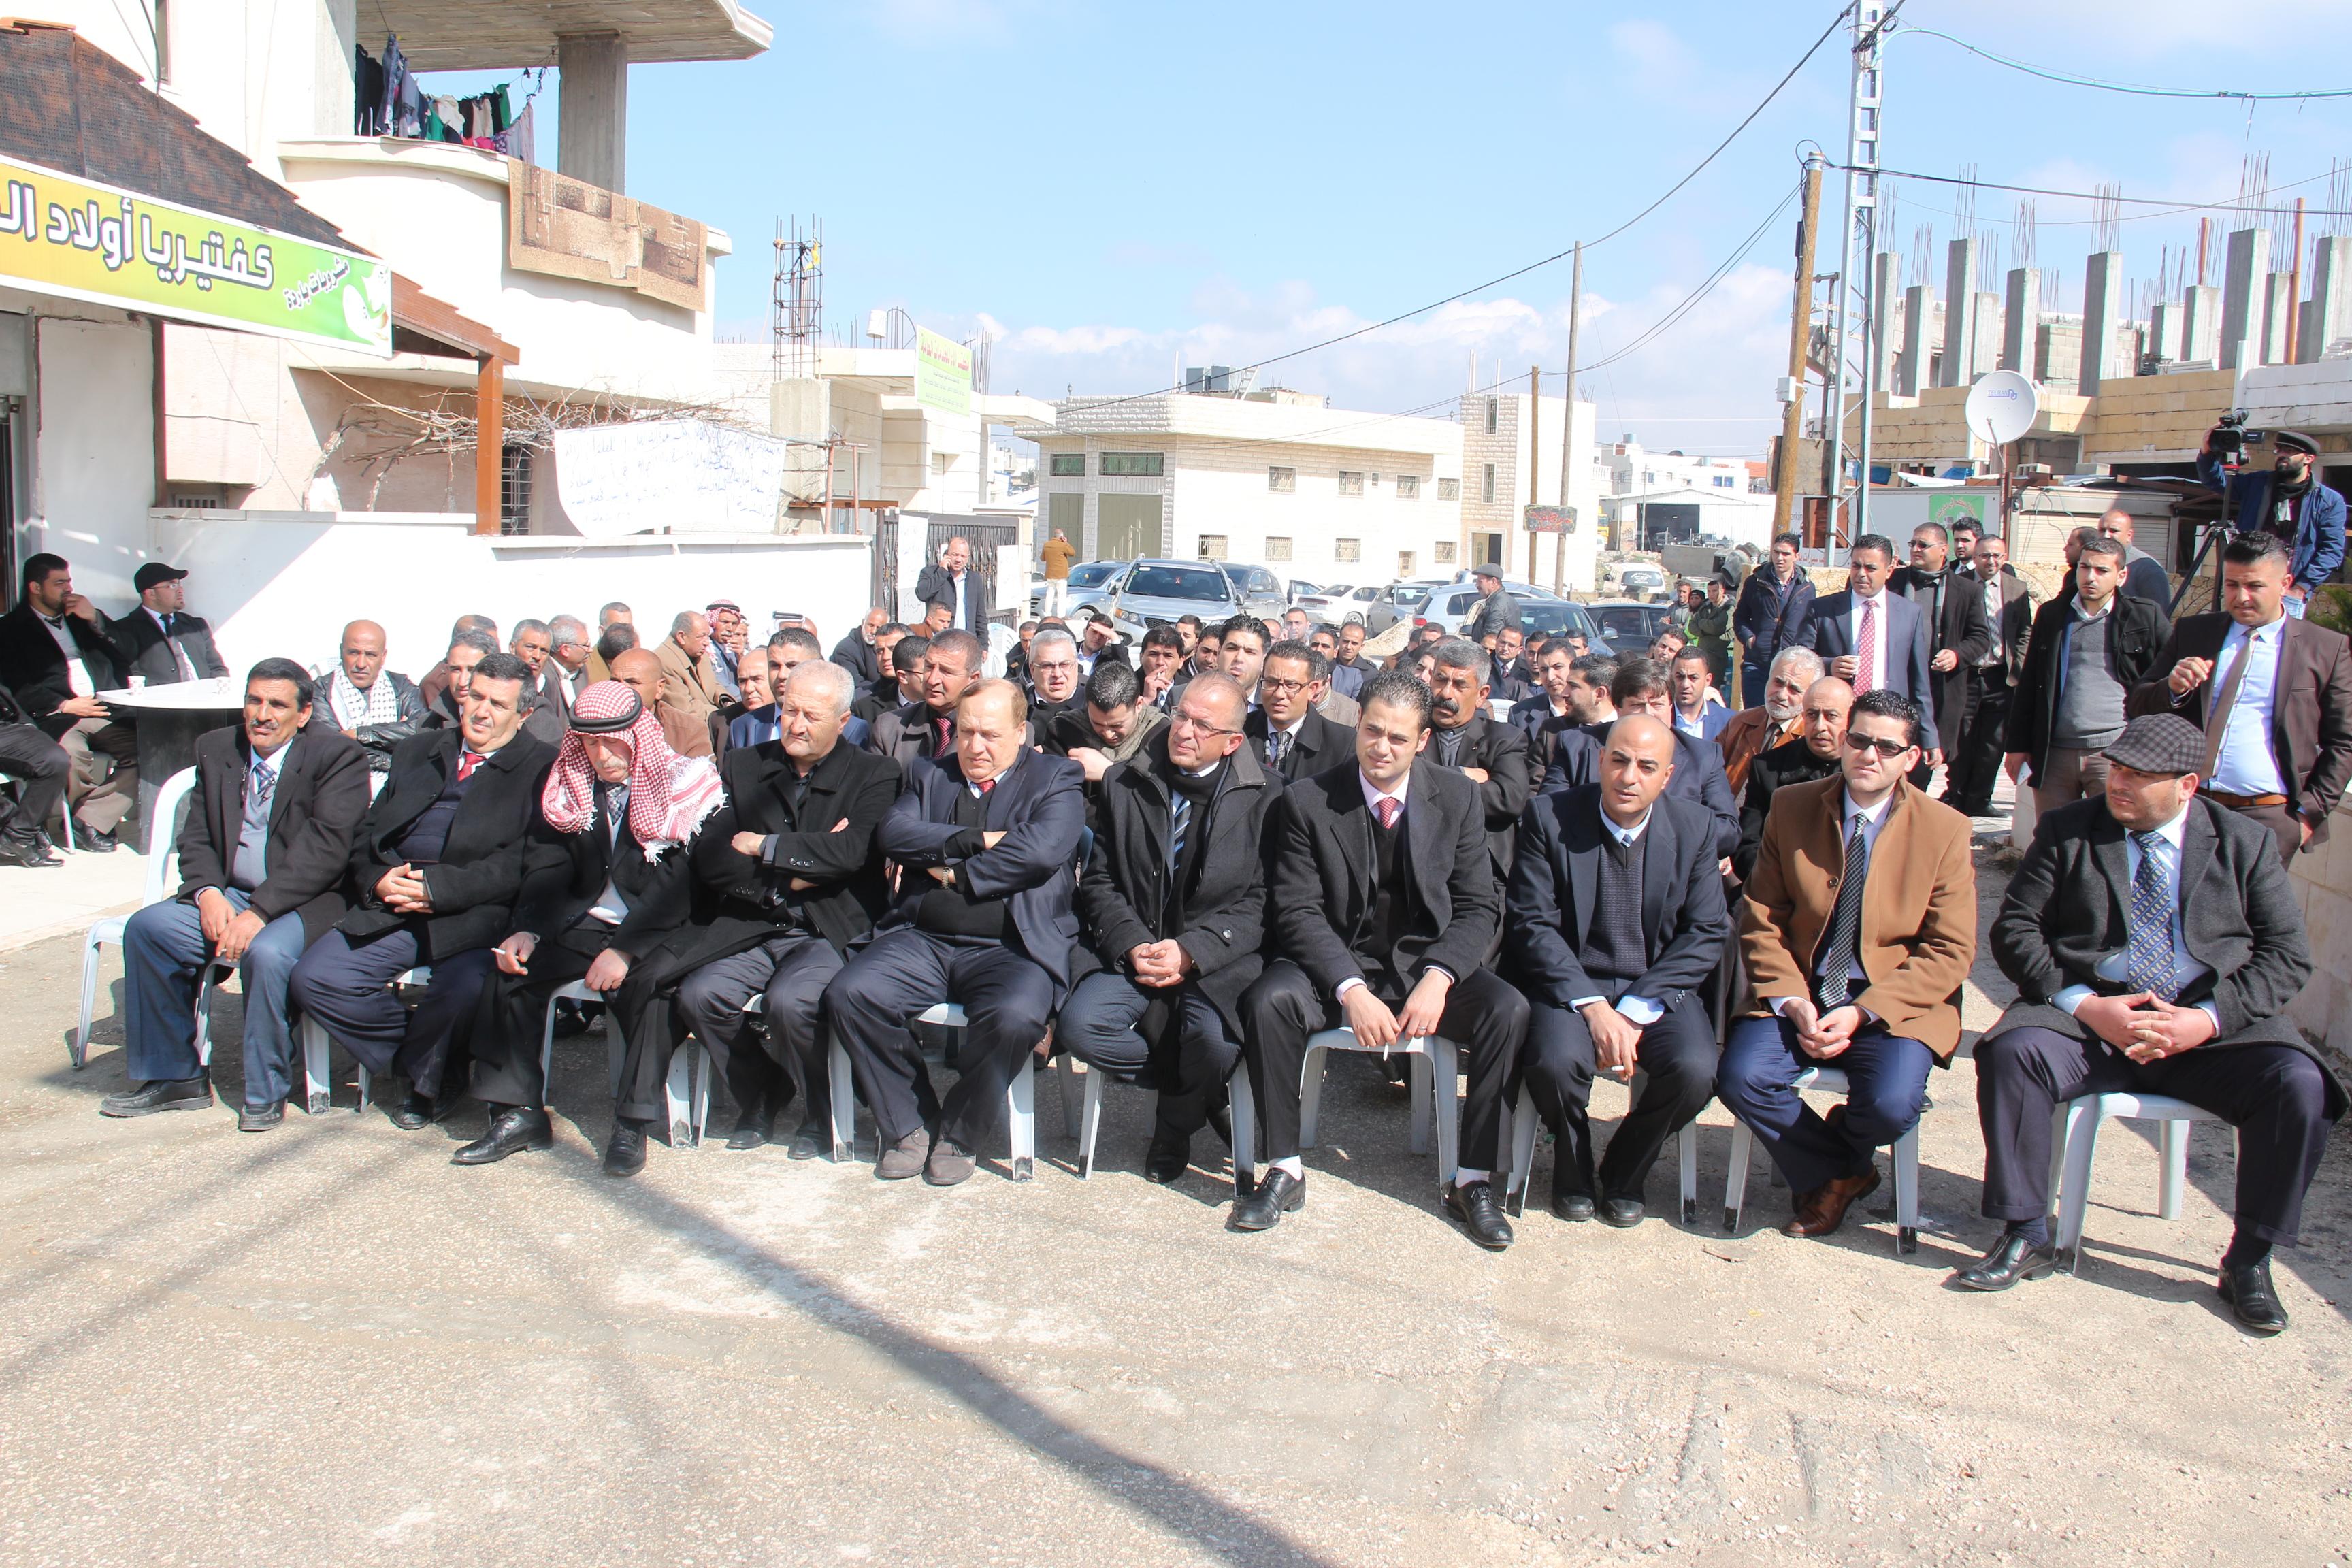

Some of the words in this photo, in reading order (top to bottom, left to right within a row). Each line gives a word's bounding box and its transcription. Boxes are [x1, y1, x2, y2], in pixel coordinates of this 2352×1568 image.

[0, 180, 38, 242] ال
[46, 196, 135, 272] أولاد
[141, 213, 274, 292] كفتيريا
[283, 281, 312, 310] باردة
